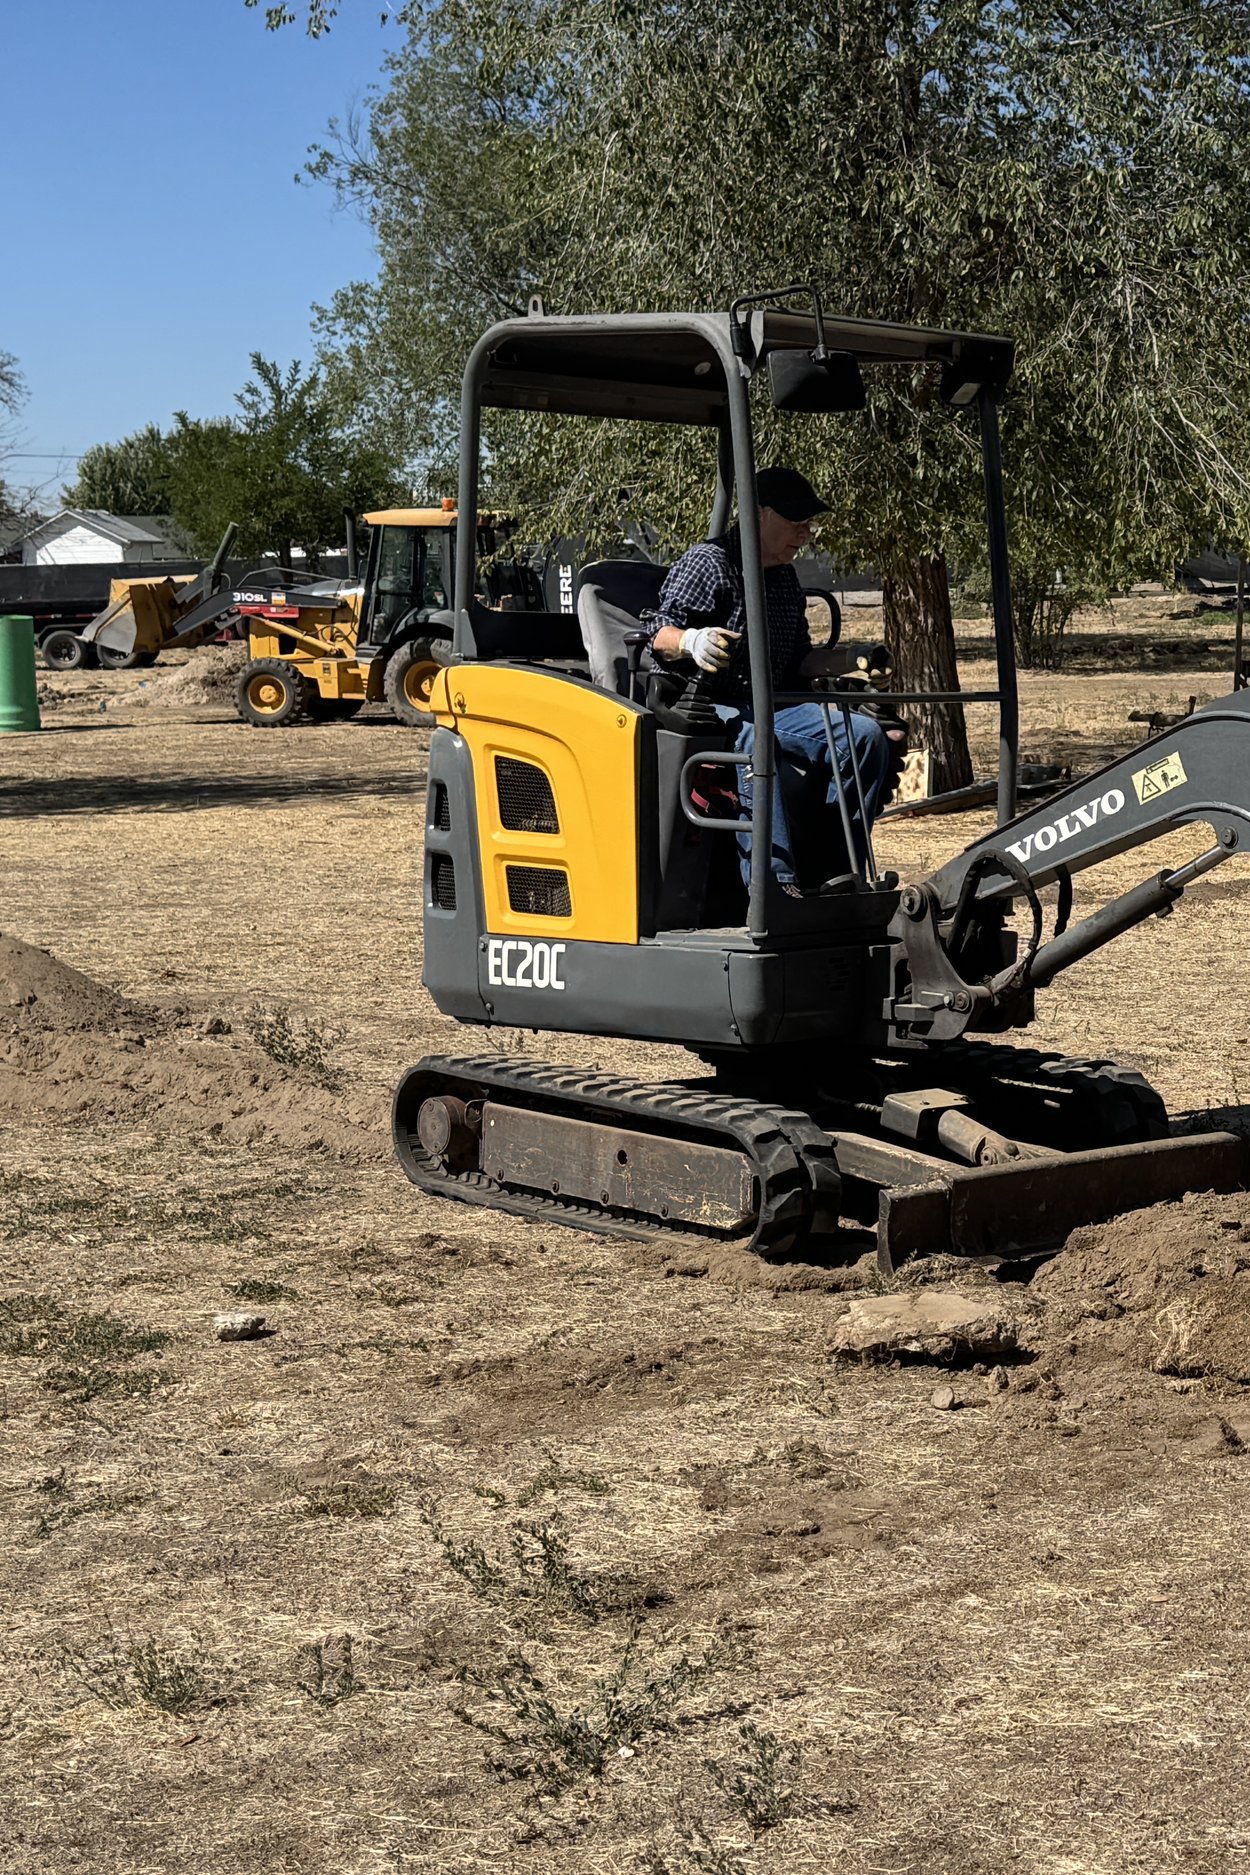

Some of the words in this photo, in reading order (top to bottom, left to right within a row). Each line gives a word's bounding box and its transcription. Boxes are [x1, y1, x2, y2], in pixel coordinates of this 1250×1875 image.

[232, 592, 268, 603] 310SL
[559, 564, 573, 614] EERE
[1005, 789, 1125, 863] VOLVO
[488, 939, 566, 991] EC20C
